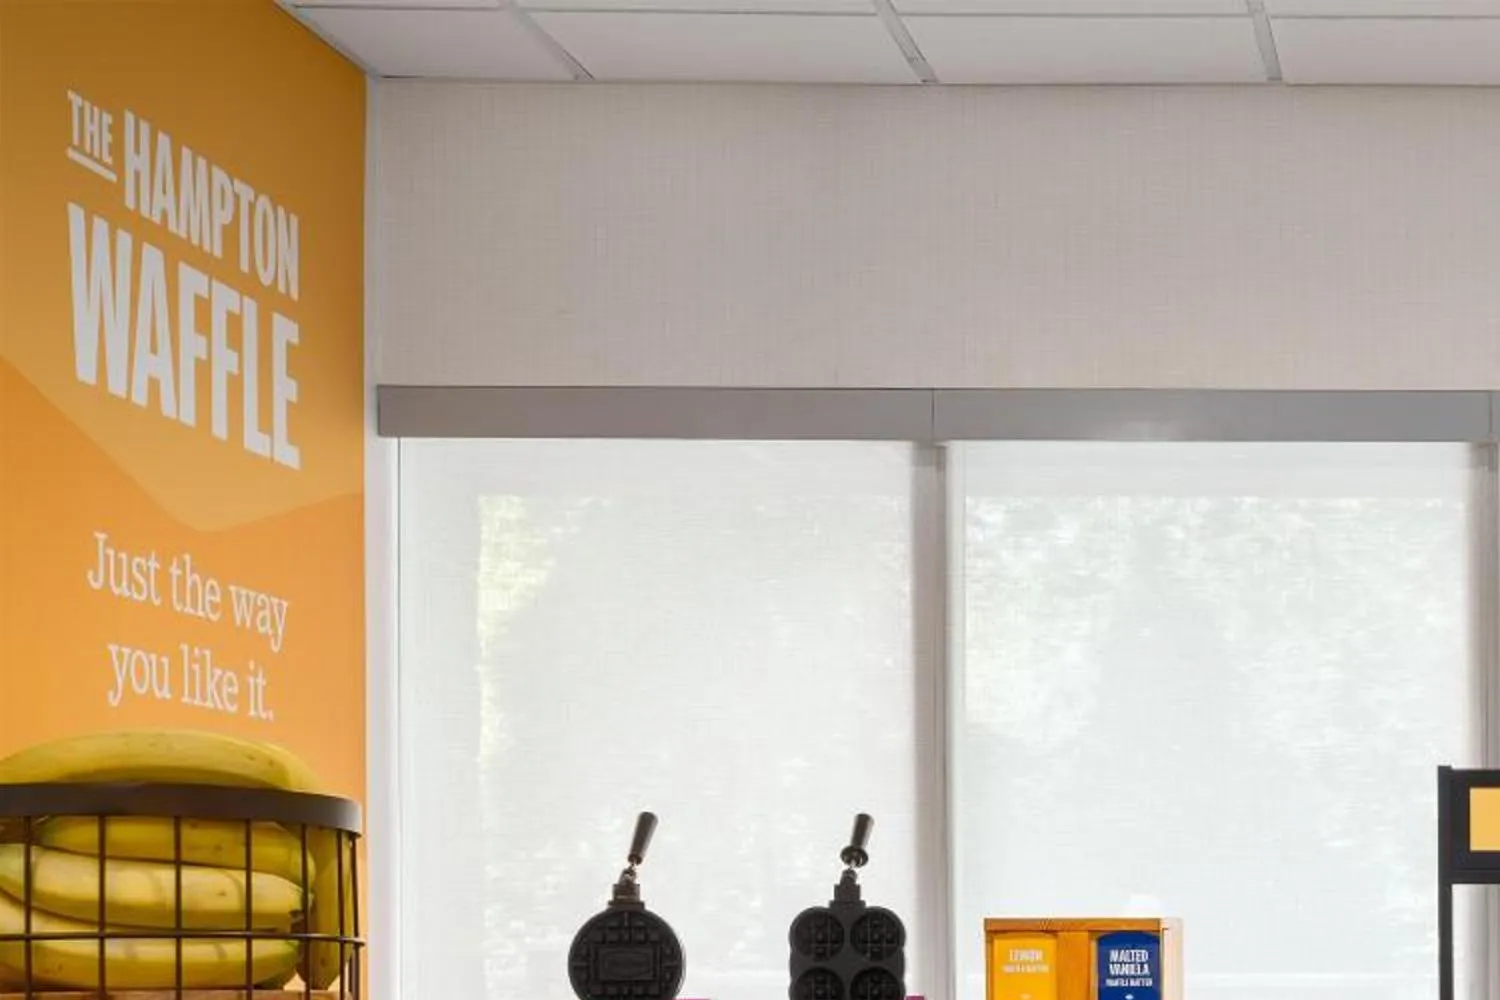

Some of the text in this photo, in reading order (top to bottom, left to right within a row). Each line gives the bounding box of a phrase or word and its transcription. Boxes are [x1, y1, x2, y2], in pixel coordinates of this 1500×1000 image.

[67, 89, 299, 301] THE HAMPTON
[67, 202, 300, 471] WAFFLE
[88, 531, 289, 654] Just the way
[107, 642, 274, 721] you like it.
[1109, 949, 1149, 962] MALTED
[1109, 963, 1150, 976] VANILLA
